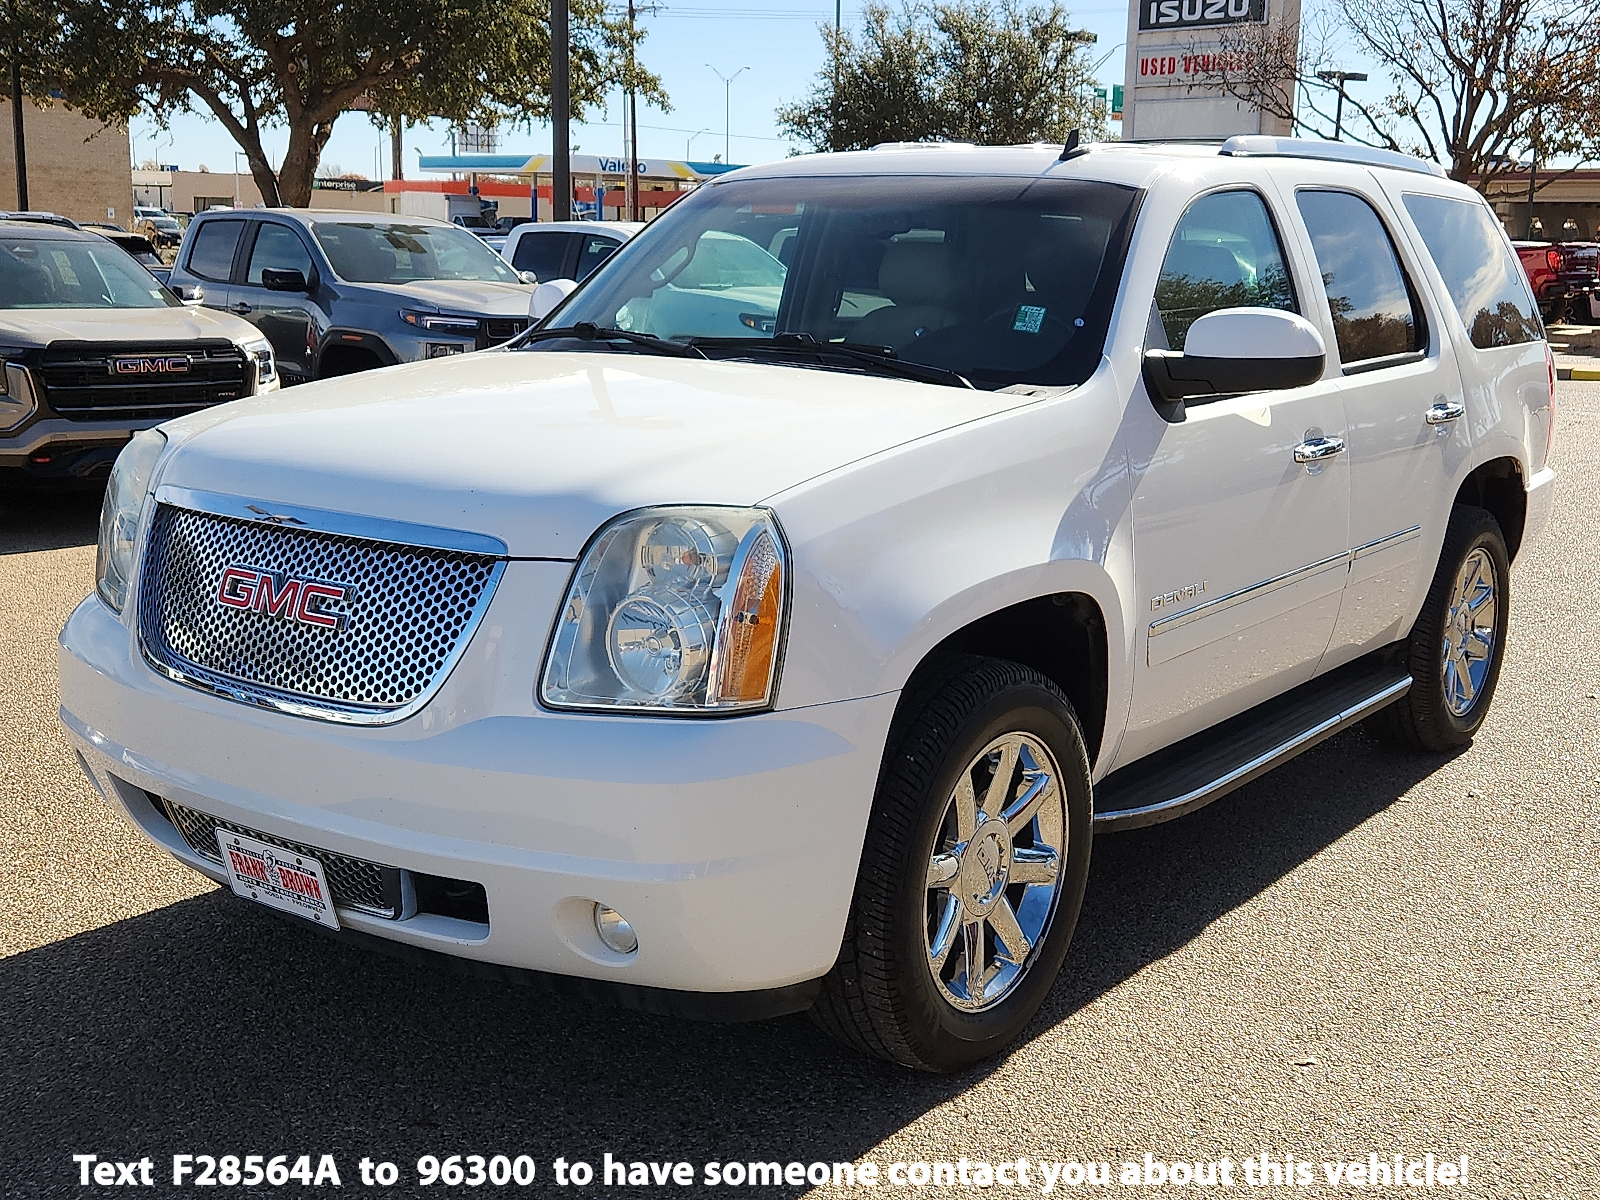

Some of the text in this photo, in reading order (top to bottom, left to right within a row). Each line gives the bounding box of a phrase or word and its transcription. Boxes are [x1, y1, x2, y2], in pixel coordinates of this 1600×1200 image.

[1150, 0, 1250, 25] ISUZU
[1140, 57, 1176, 76] USED
[598, 157, 647, 174] Valeo
[116, 357, 189, 374] GMC
[217, 566, 349, 630] GMC
[1150, 580, 1209, 612] DENALI
[228, 850, 269, 883] FRANK
[277, 866, 323, 901] BROWN
